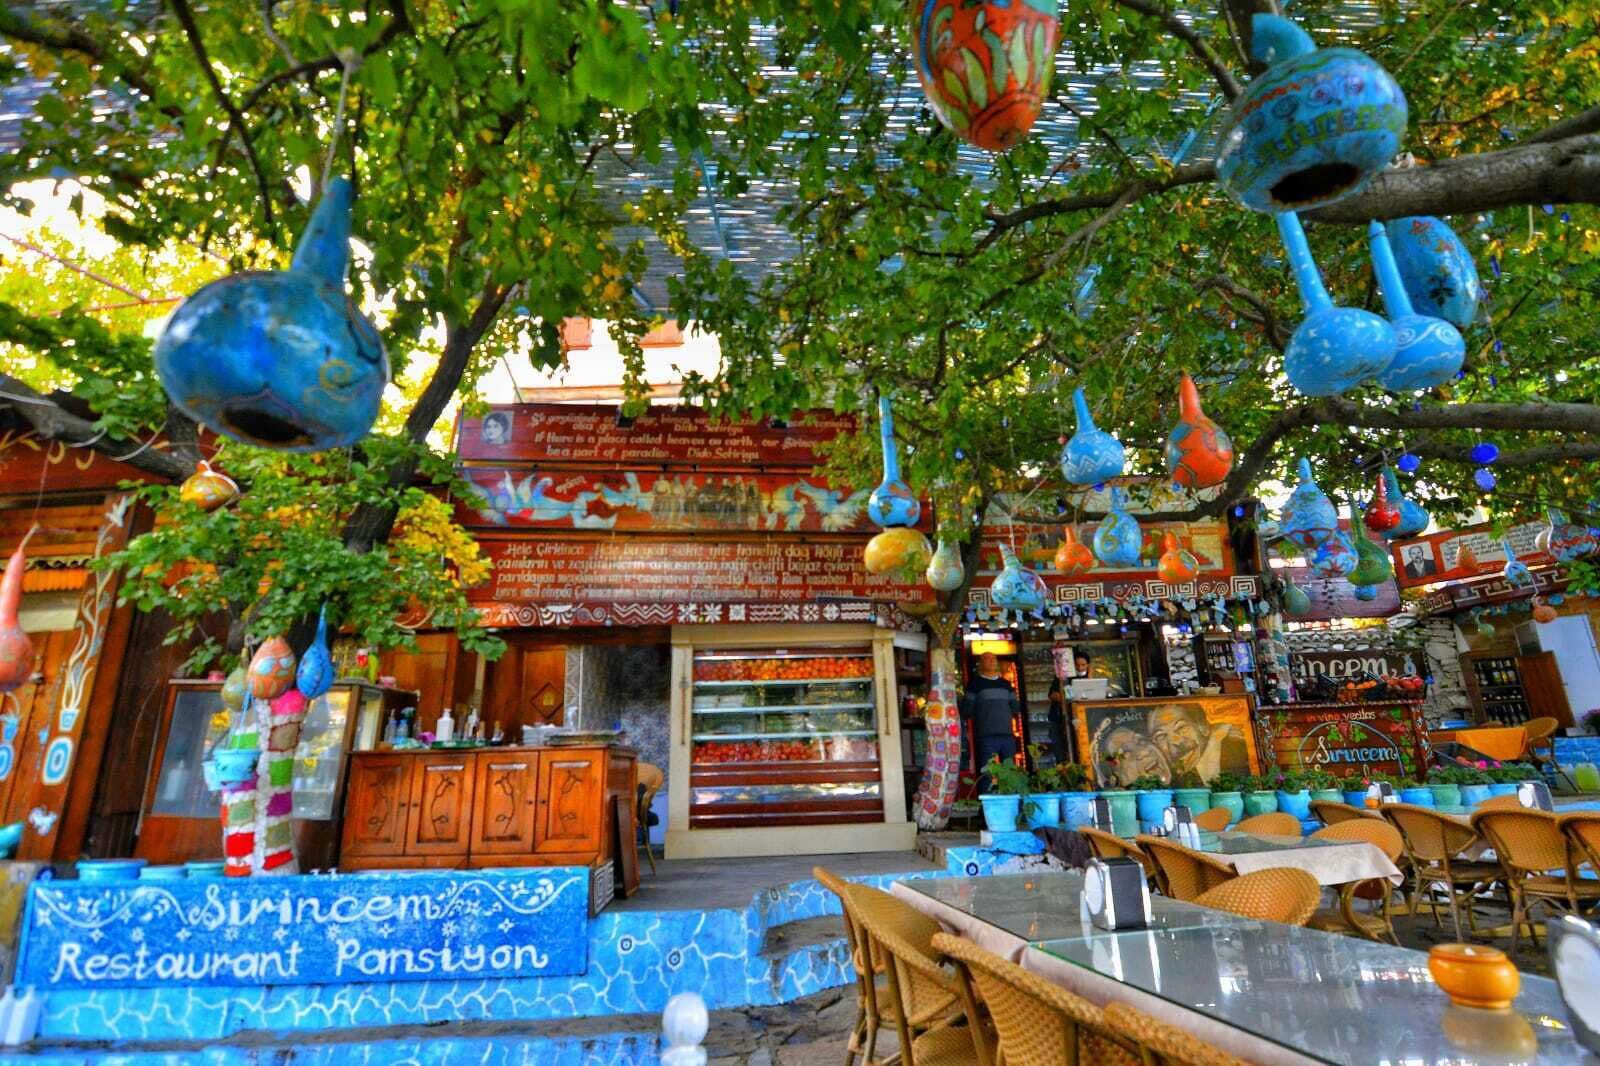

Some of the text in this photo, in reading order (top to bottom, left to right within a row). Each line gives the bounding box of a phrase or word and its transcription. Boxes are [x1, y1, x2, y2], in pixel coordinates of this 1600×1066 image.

[588, 436, 596, 444] a
[598, 433, 628, 447] place
[630, 433, 664, 445] called
[573, 446, 598, 459] part
[603, 447, 616, 460] of
[51, 938, 549, 983] Restaurant Pansiyon
